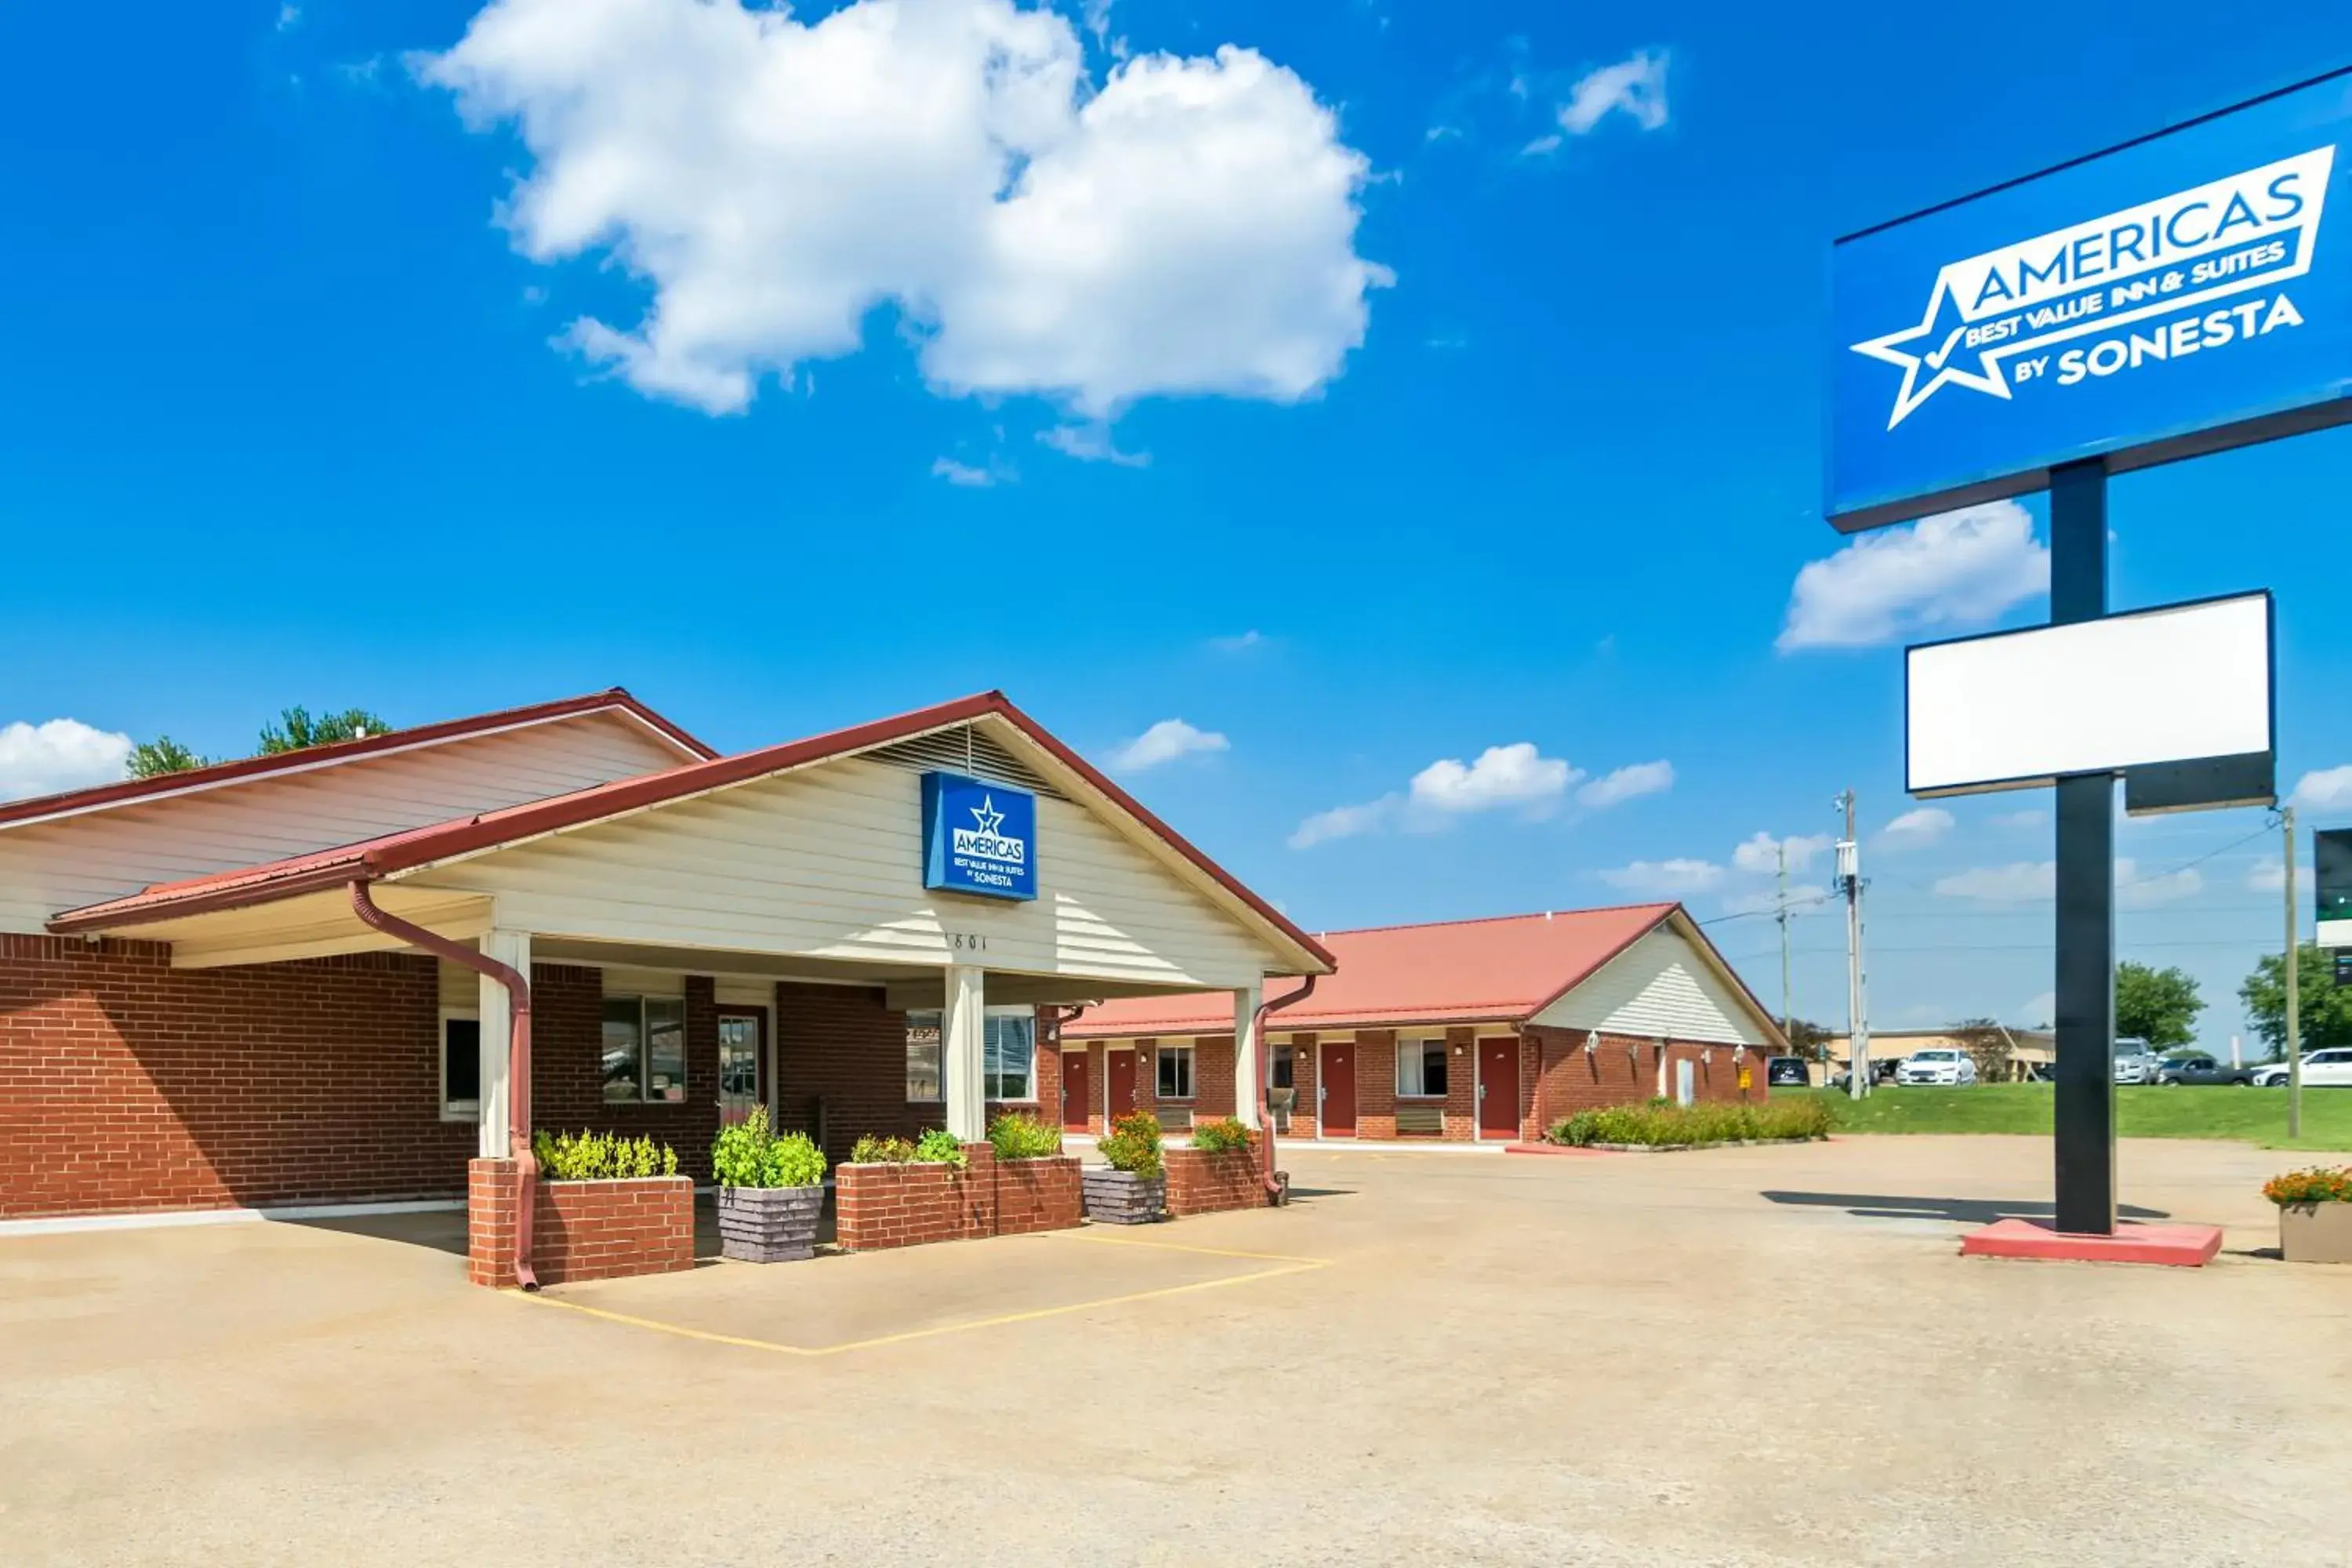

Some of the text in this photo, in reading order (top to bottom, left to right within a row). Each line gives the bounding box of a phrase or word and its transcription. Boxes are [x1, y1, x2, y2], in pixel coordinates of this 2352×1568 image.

[1972, 172, 2305, 310] AMERICAS
[1965, 241, 2286, 349] BEST VALUE INN & SUITES
[2015, 292, 2304, 386] BY SONESTA
[956, 833, 1022, 860] AMERICAS
[974, 871, 1012, 887] SONESTA
